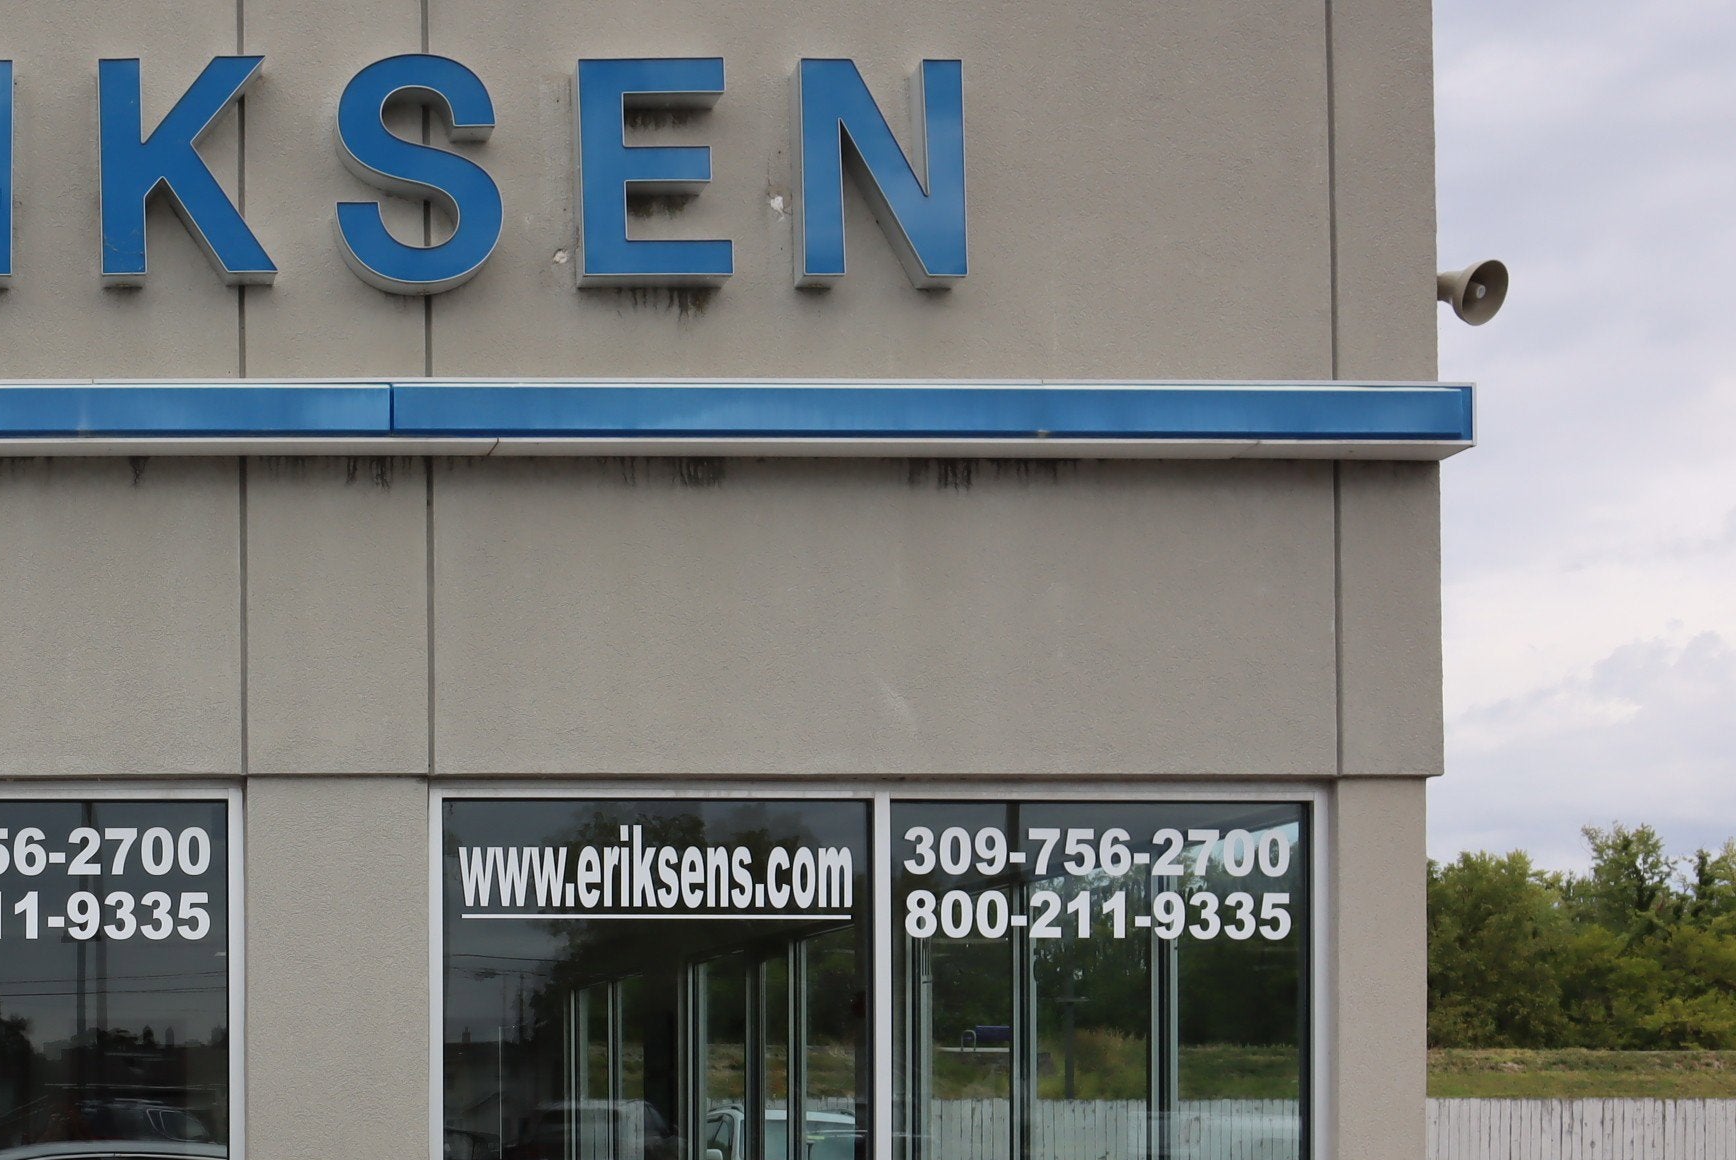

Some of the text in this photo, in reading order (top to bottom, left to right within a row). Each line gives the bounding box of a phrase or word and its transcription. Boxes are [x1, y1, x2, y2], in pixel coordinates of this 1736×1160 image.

[459, 824, 853, 909] www.eriksens.com
[904, 826, 1292, 878] 309-756-2700
[905, 889, 1292, 940] 800-211-9335
